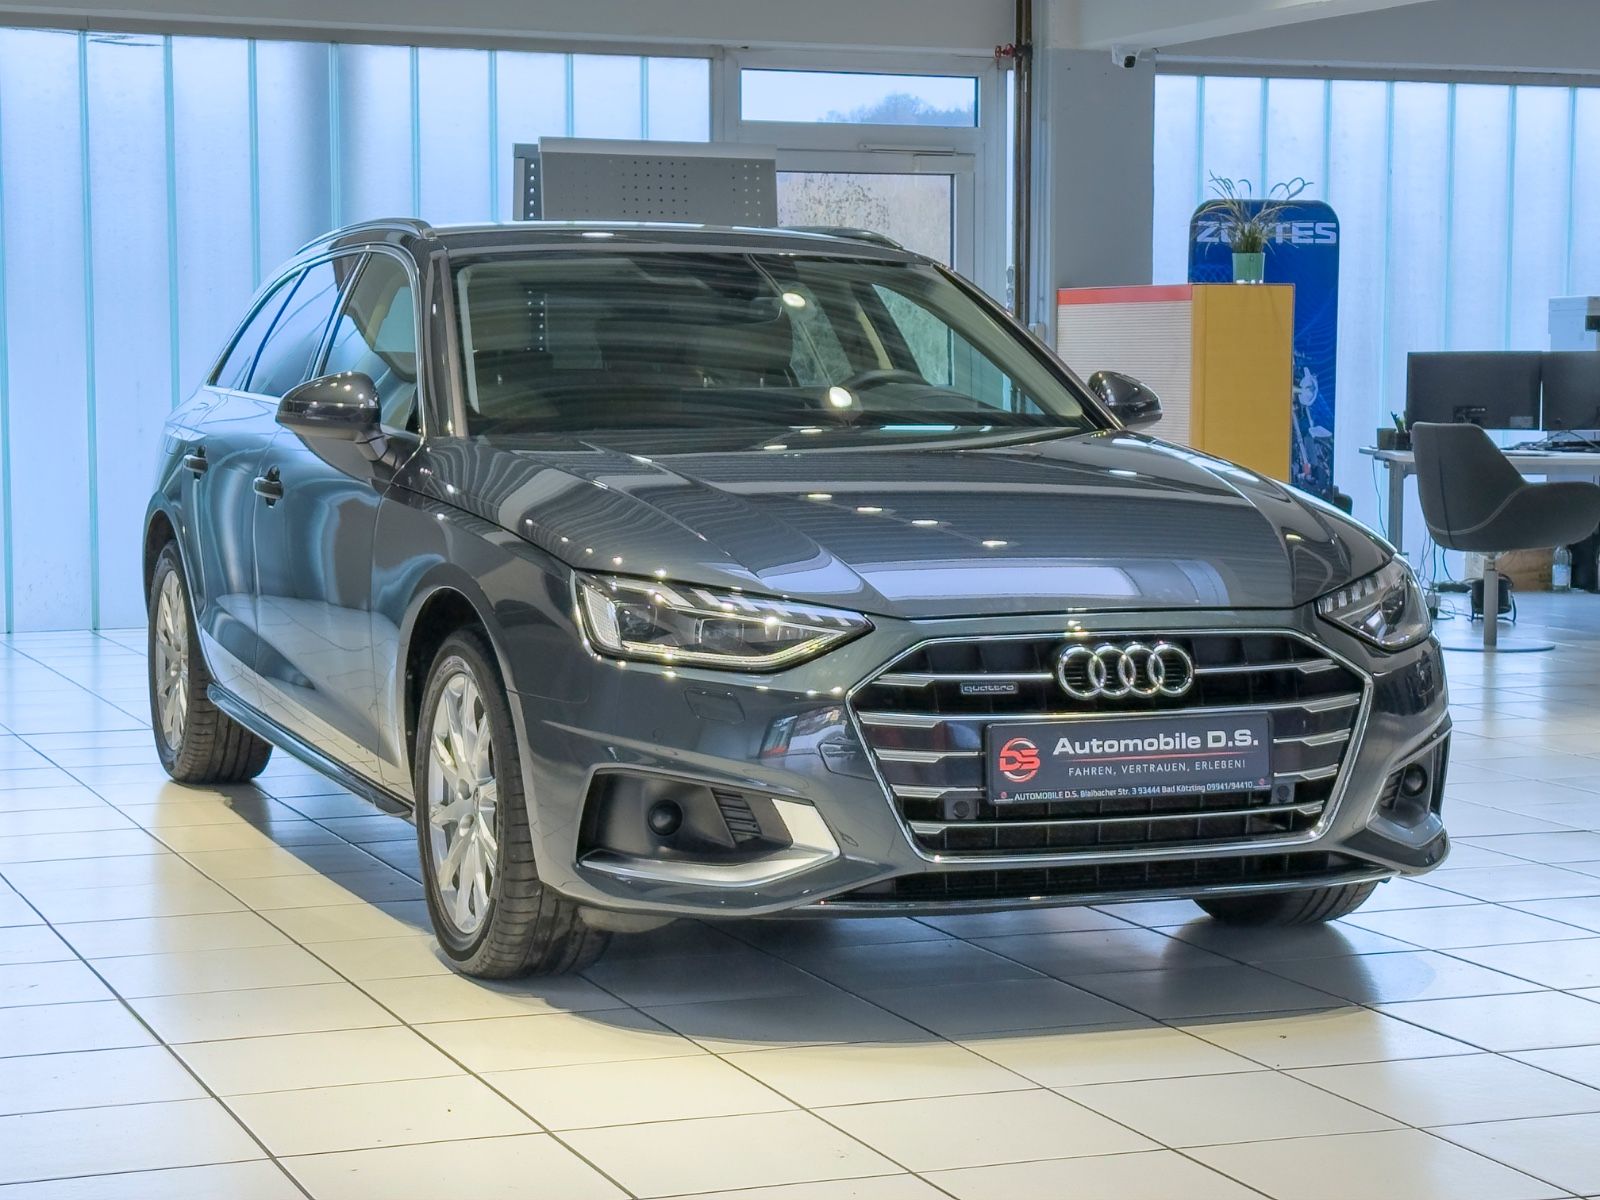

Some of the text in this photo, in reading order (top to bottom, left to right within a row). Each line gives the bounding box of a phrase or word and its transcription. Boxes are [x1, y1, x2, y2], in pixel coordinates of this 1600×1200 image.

[1197, 220, 1337, 244] ZTES
[963, 684, 1015, 693] quattro
[1052, 729, 1259, 756] Automobile D.S.
[1068, 759, 1246, 777] FAHREN, VERTRAUEN, ERLEBEN!
[1014, 791, 1063, 801] AUTOMOBILE
[1064, 791, 1079, 799] D.S.
[1117, 787, 1130, 796] Str.
[1131, 787, 1137, 795] 3
[1138, 785, 1160, 795] 93444
[1161, 784, 1176, 794] Bad
[1176, 783, 1206, 794] Kötzting
[1206, 780, 1253, 791] 09941/94410
